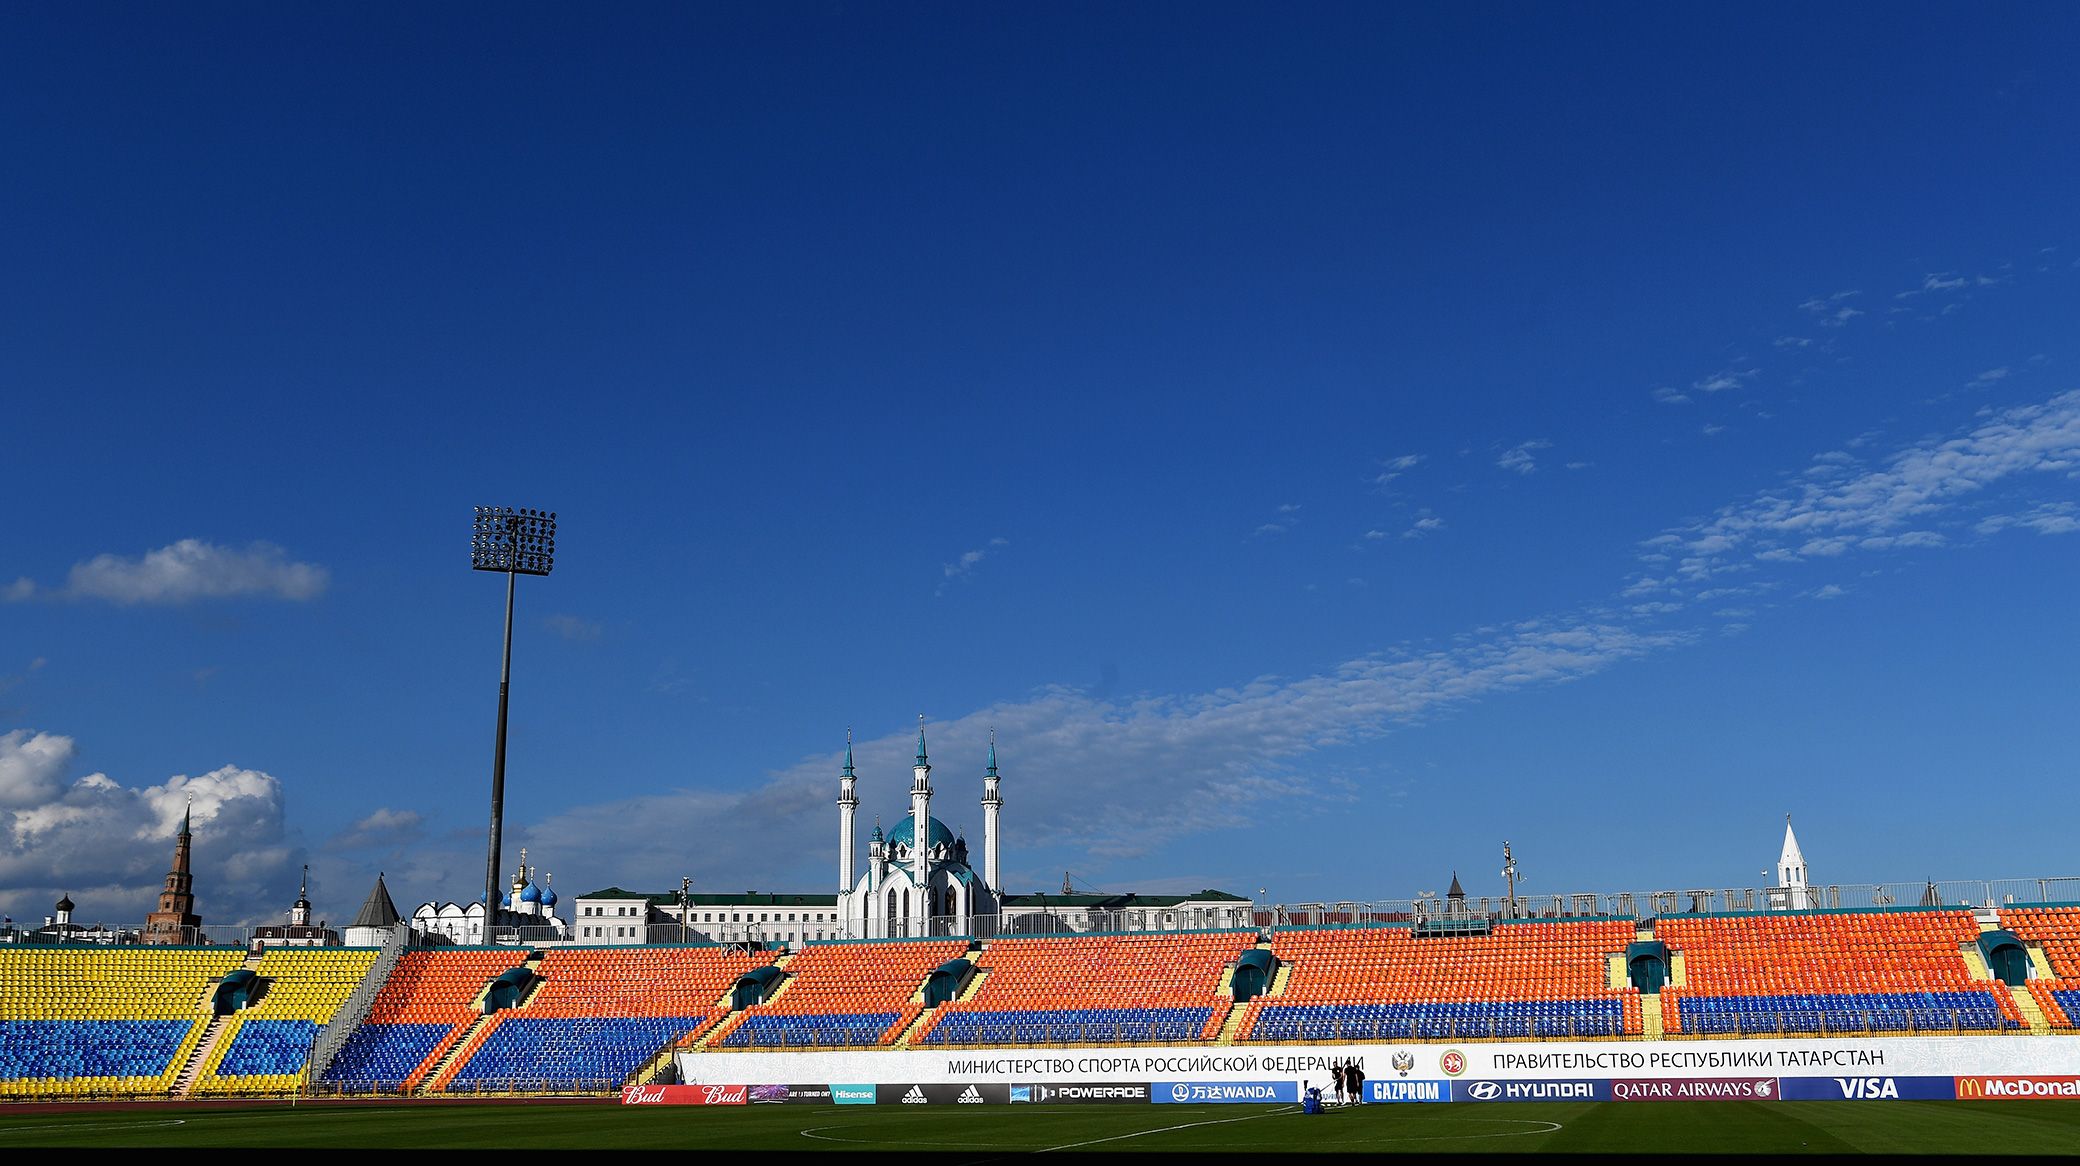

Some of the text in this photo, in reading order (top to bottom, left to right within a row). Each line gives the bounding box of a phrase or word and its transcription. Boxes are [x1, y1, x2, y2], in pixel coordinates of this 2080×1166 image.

[948, 1058, 1074, 1074] МИНИСТЕРСТВО
[1078, 1057, 1140, 1073] СПОРТА
[1145, 1054, 1257, 1072] РОССИЙСКОЙ
[1493, 1050, 1884, 1069] ПРАВИТЕЛЬСТВО РЕСПУБЛИКИ ТАТАРСТАН
[622, 1086, 664, 1104] Bud
[702, 1085, 745, 1104] Bud
[835, 1090, 873, 1099] Hisense
[1058, 1087, 1144, 1098] POWERADE
[1373, 1082, 1439, 1100] GAZPROM
[1506, 1083, 1594, 1097] HYUNDAI
[1614, 1082, 1751, 1098] QATAR AIRWAYS
[1834, 1078, 1899, 1098] VISA
[901, 1096, 927, 1104] adidas
[957, 1096, 983, 1104] adidas
